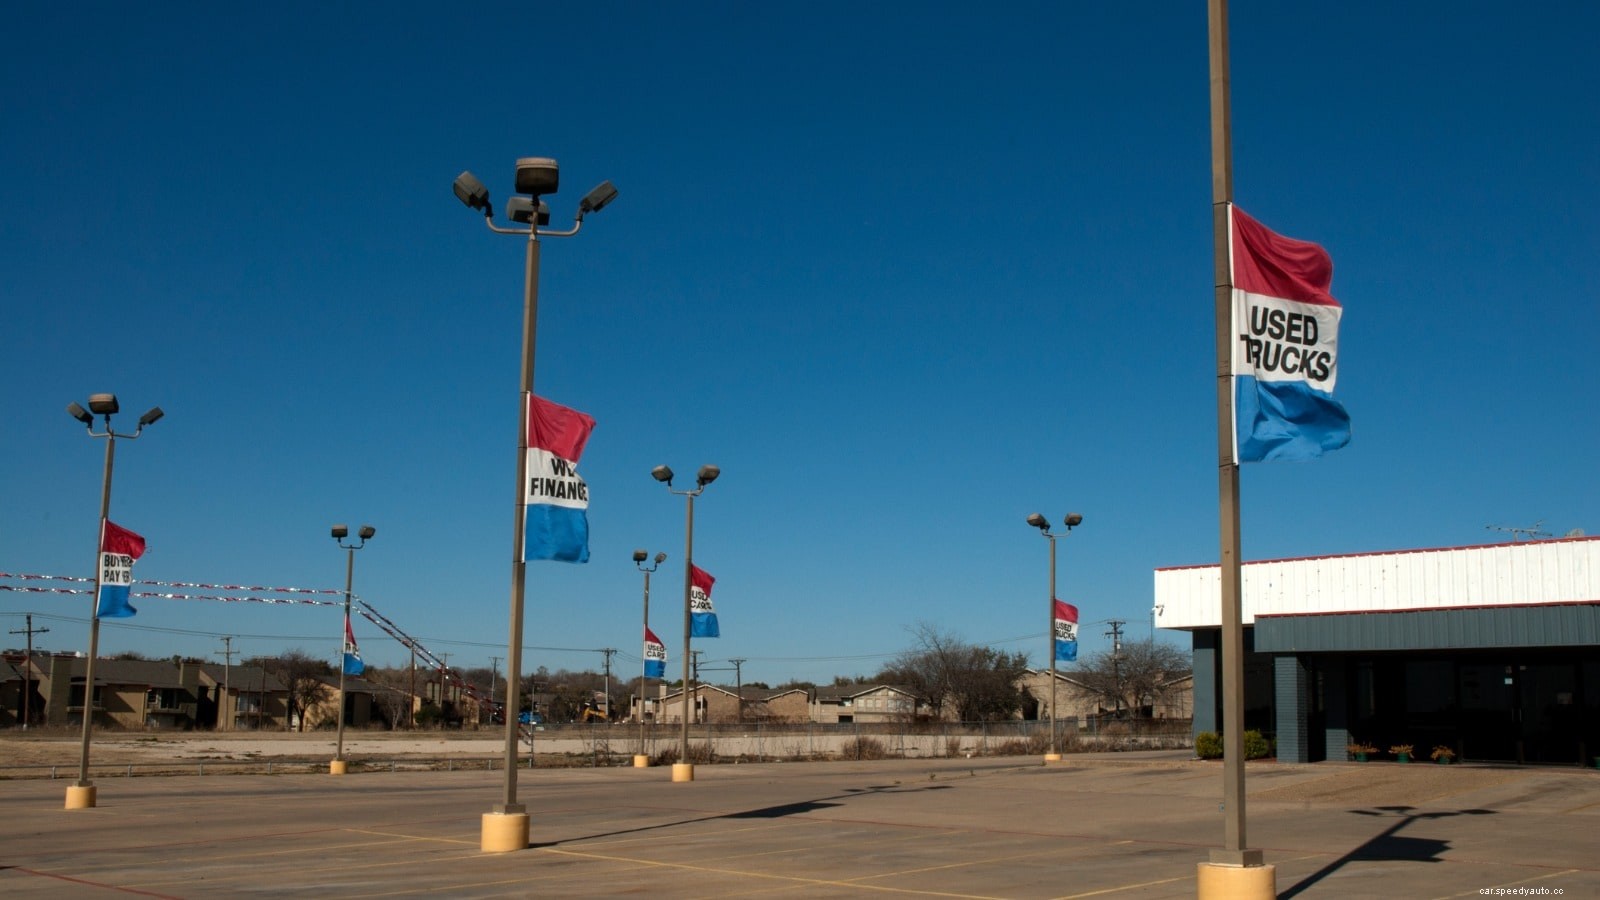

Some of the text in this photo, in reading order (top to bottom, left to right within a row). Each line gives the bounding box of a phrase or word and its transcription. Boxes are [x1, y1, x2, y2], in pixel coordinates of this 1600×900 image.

[1251, 305, 1318, 346] USED
[1240, 334, 1331, 382] TRUCKS
[104, 569, 120, 582] PAY
